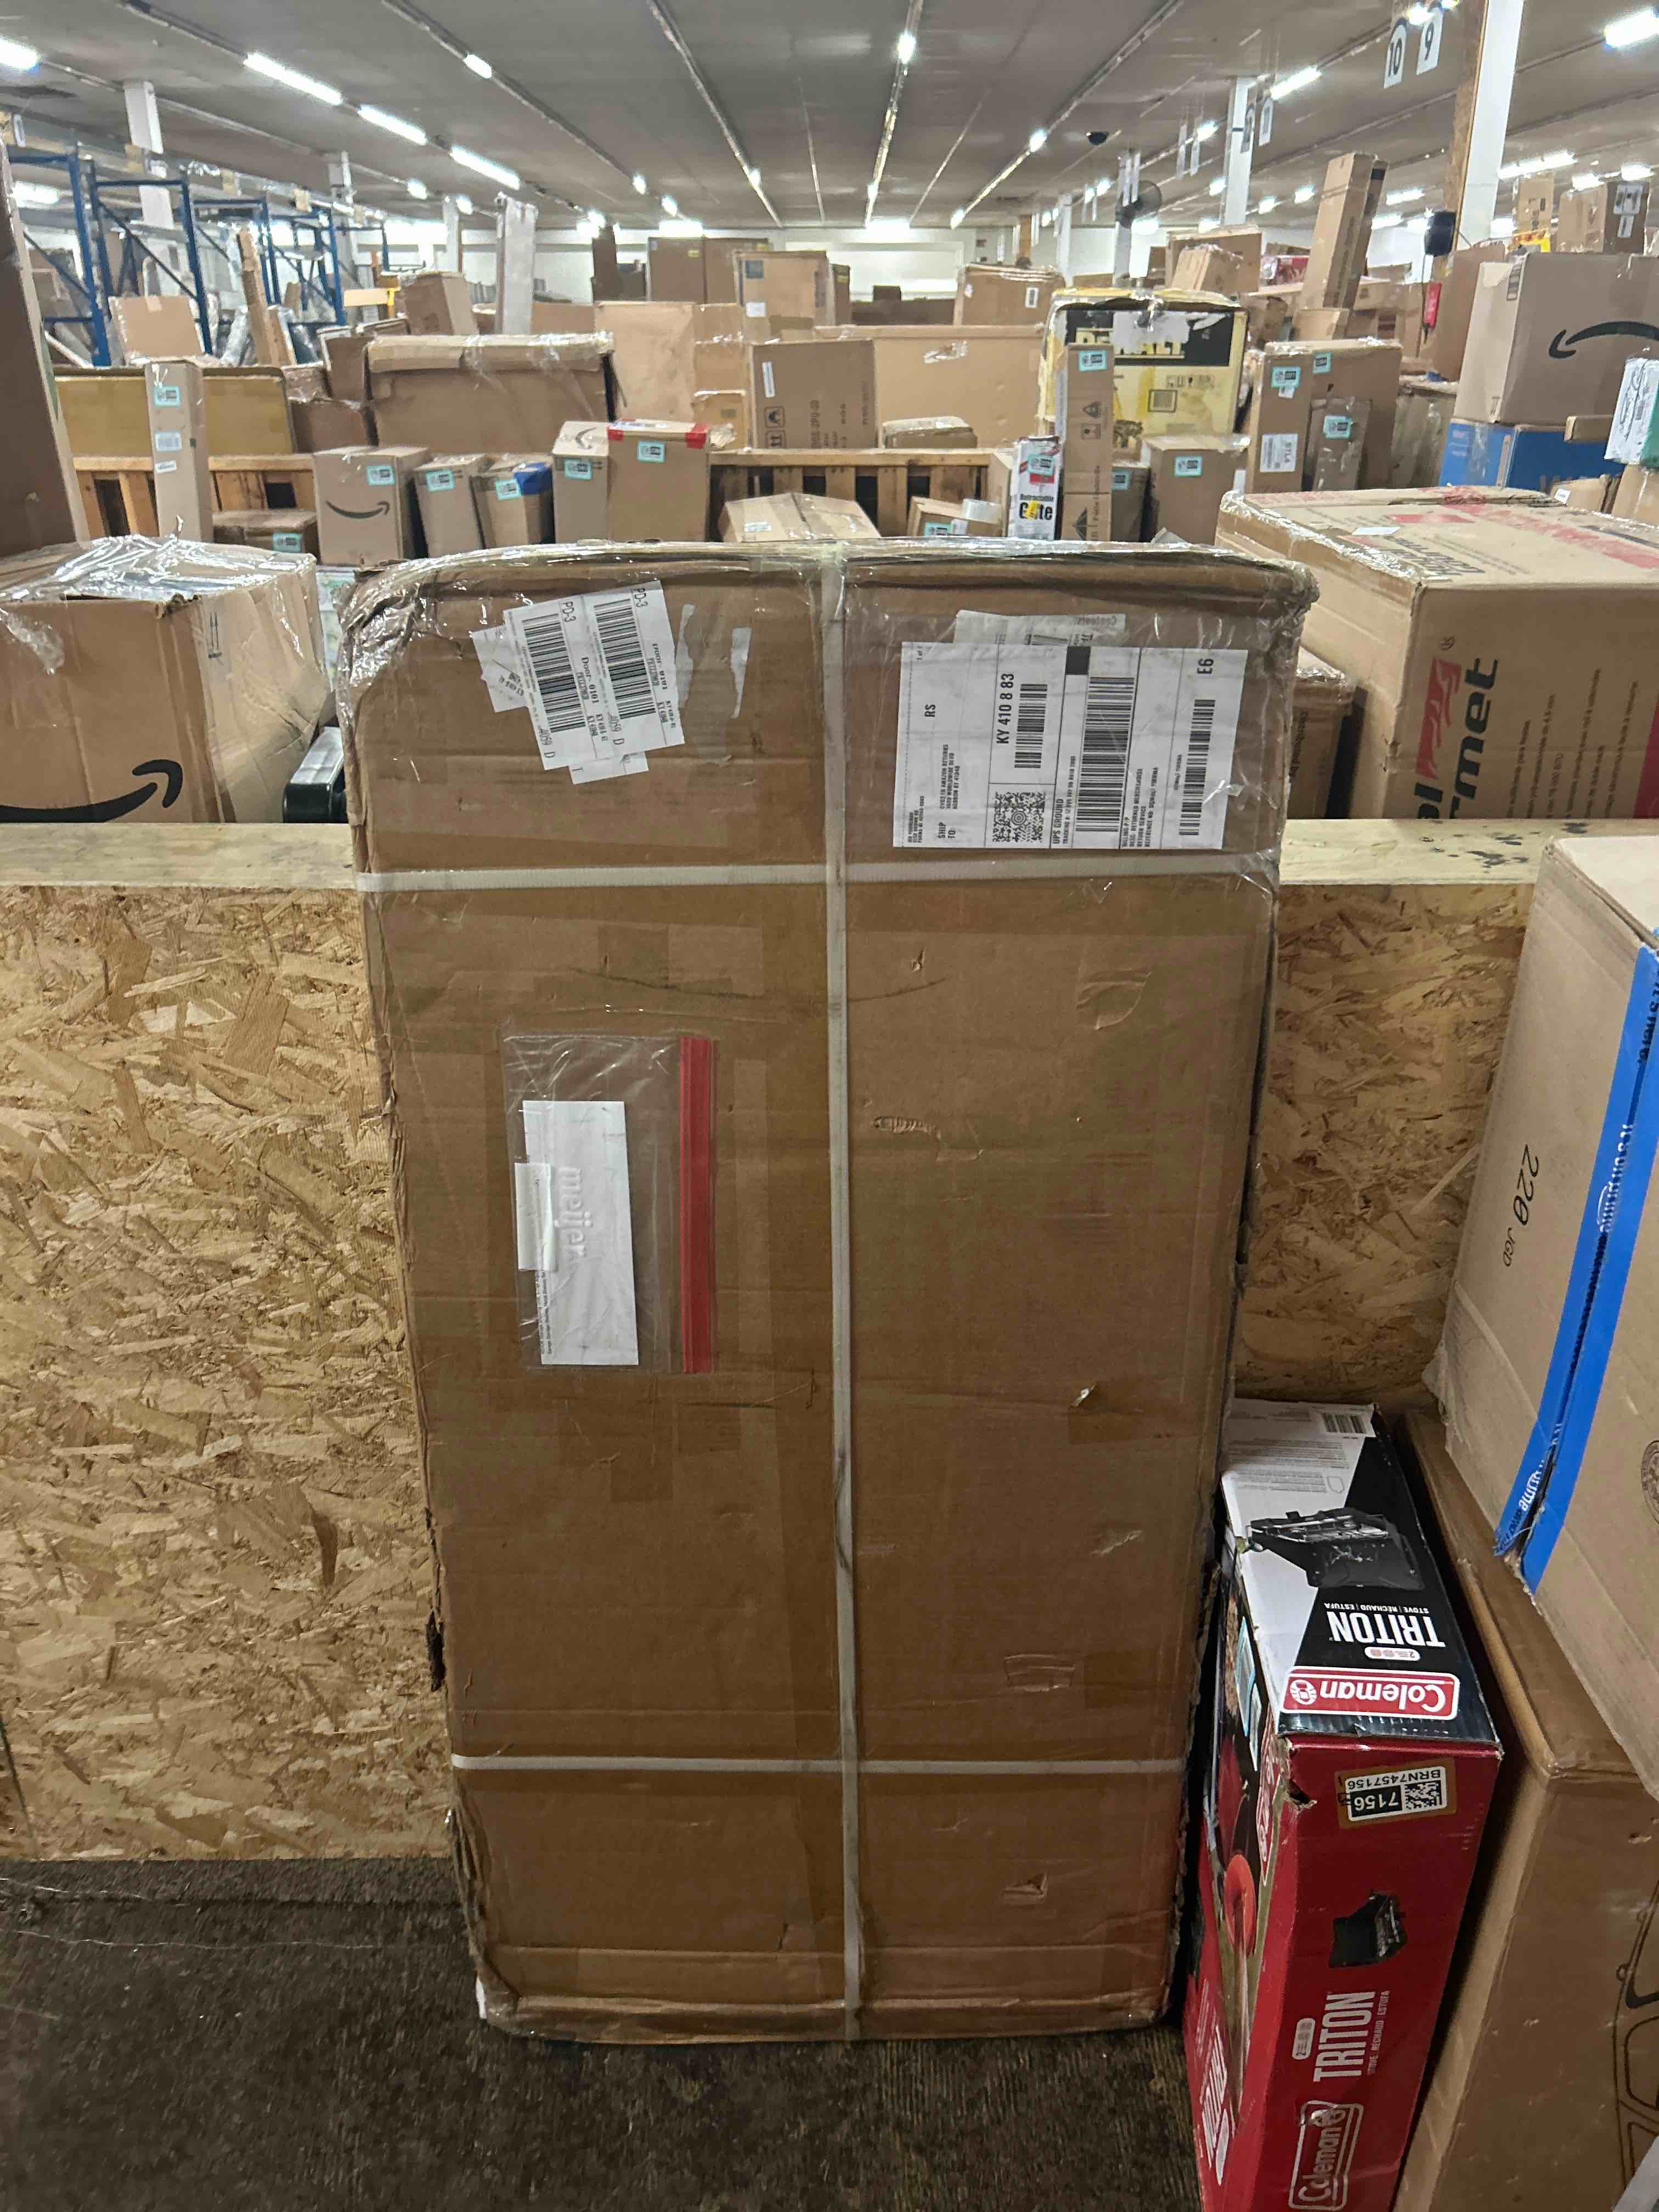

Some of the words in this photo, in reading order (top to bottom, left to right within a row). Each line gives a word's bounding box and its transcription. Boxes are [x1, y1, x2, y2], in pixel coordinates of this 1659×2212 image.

[1424, 22, 1434, 61] 9
[1388, 38, 1403, 77] 10
[633, 588, 648, 608] PD-3
[561, 601, 576, 623] PD-3
[1197, 658, 1214, 675] E6
[1001, 673, 1014, 690] 83
[588, 684, 599, 704] 0101
[924, 703, 936, 718] RS
[998, 703, 1012, 726] 410
[996, 729, 1010, 744] KY
[1054, 799, 1064, 828] GROUND
[938, 822, 946, 839] SHIP
[1052, 829, 1061, 844] UPS
[1513, 1144, 1539, 1226] 220
[553, 1166, 593, 1258] meijer
[1503, 1227, 1516, 1267] JGD
[1323, 1602, 1355, 1611] ESTUFA
[1325, 1611, 1447, 1647] TRITON
[1319, 1680, 1446, 1713] Coleman
[1347, 1769, 1441, 1790] BRN7457156
[1353, 1791, 1400, 1811] 7156
[1313, 1991, 1376, 2083] TRITON
[1297, 2124, 1342, 2202] Coleman
